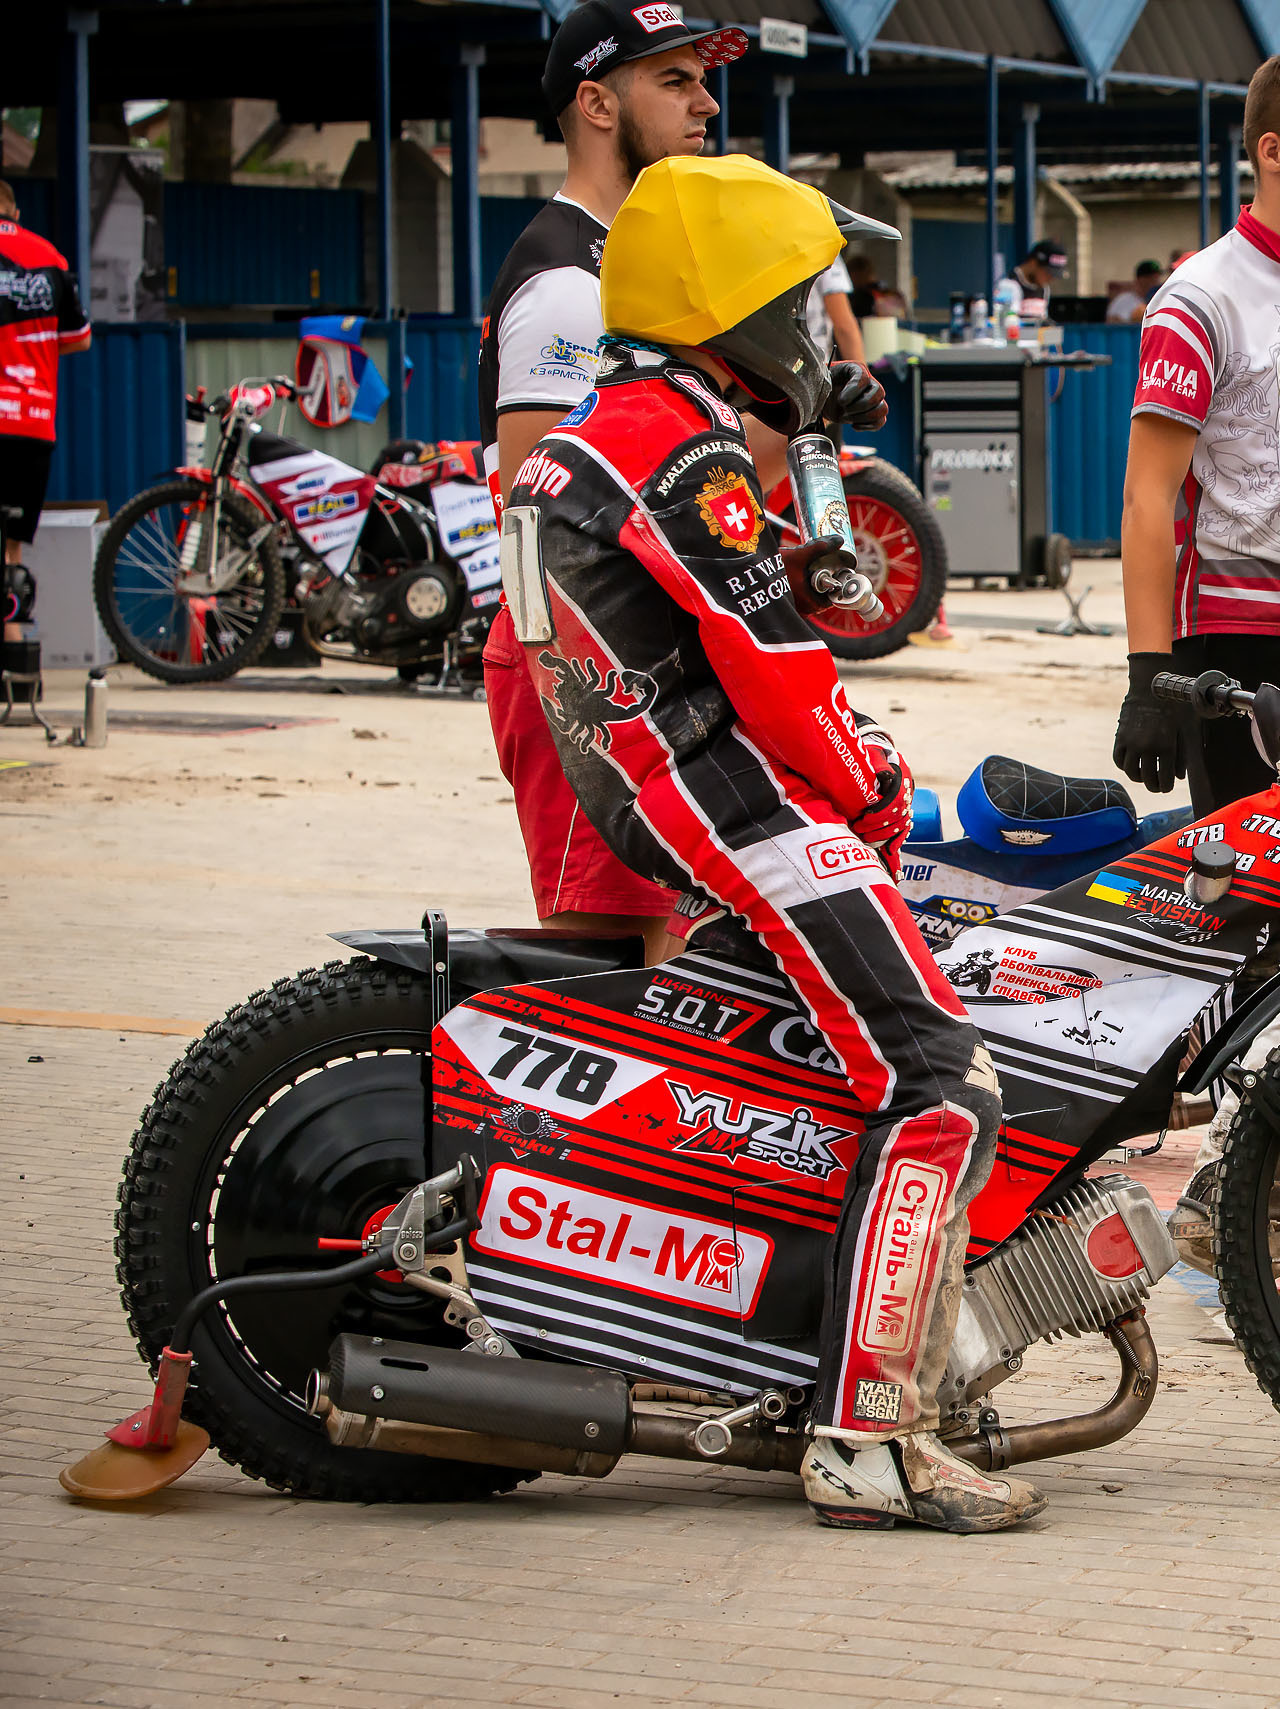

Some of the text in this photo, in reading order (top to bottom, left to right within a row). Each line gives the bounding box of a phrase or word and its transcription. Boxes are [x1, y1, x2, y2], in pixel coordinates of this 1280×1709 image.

[1142, 359, 1198, 390] LTVIA
[1171, 382, 1197, 400] TEAM
[726, 552, 786, 596] RIVNE
[1178, 823, 1225, 848] #778
[1125, 893, 1227, 932] LEVISHYN
[1003, 946, 1038, 961] КЛУБ
[995, 971, 1081, 999] РІВНЕНСЬКОГО
[1000, 958, 1103, 989] ВБОЛІВАЛЬНИКІВ
[651, 974, 736, 1007] UKRAINE
[992, 984, 1047, 1005] СПІДВЕЮ
[633, 1010, 668, 1026] STANISLAV
[707, 1032, 731, 1045] TUNING
[488, 1026, 618, 1106] 778
[689, 1128, 749, 1154] MX
[747, 1141, 834, 1176] SPORT
[859, 1381, 901, 1398] MALI
